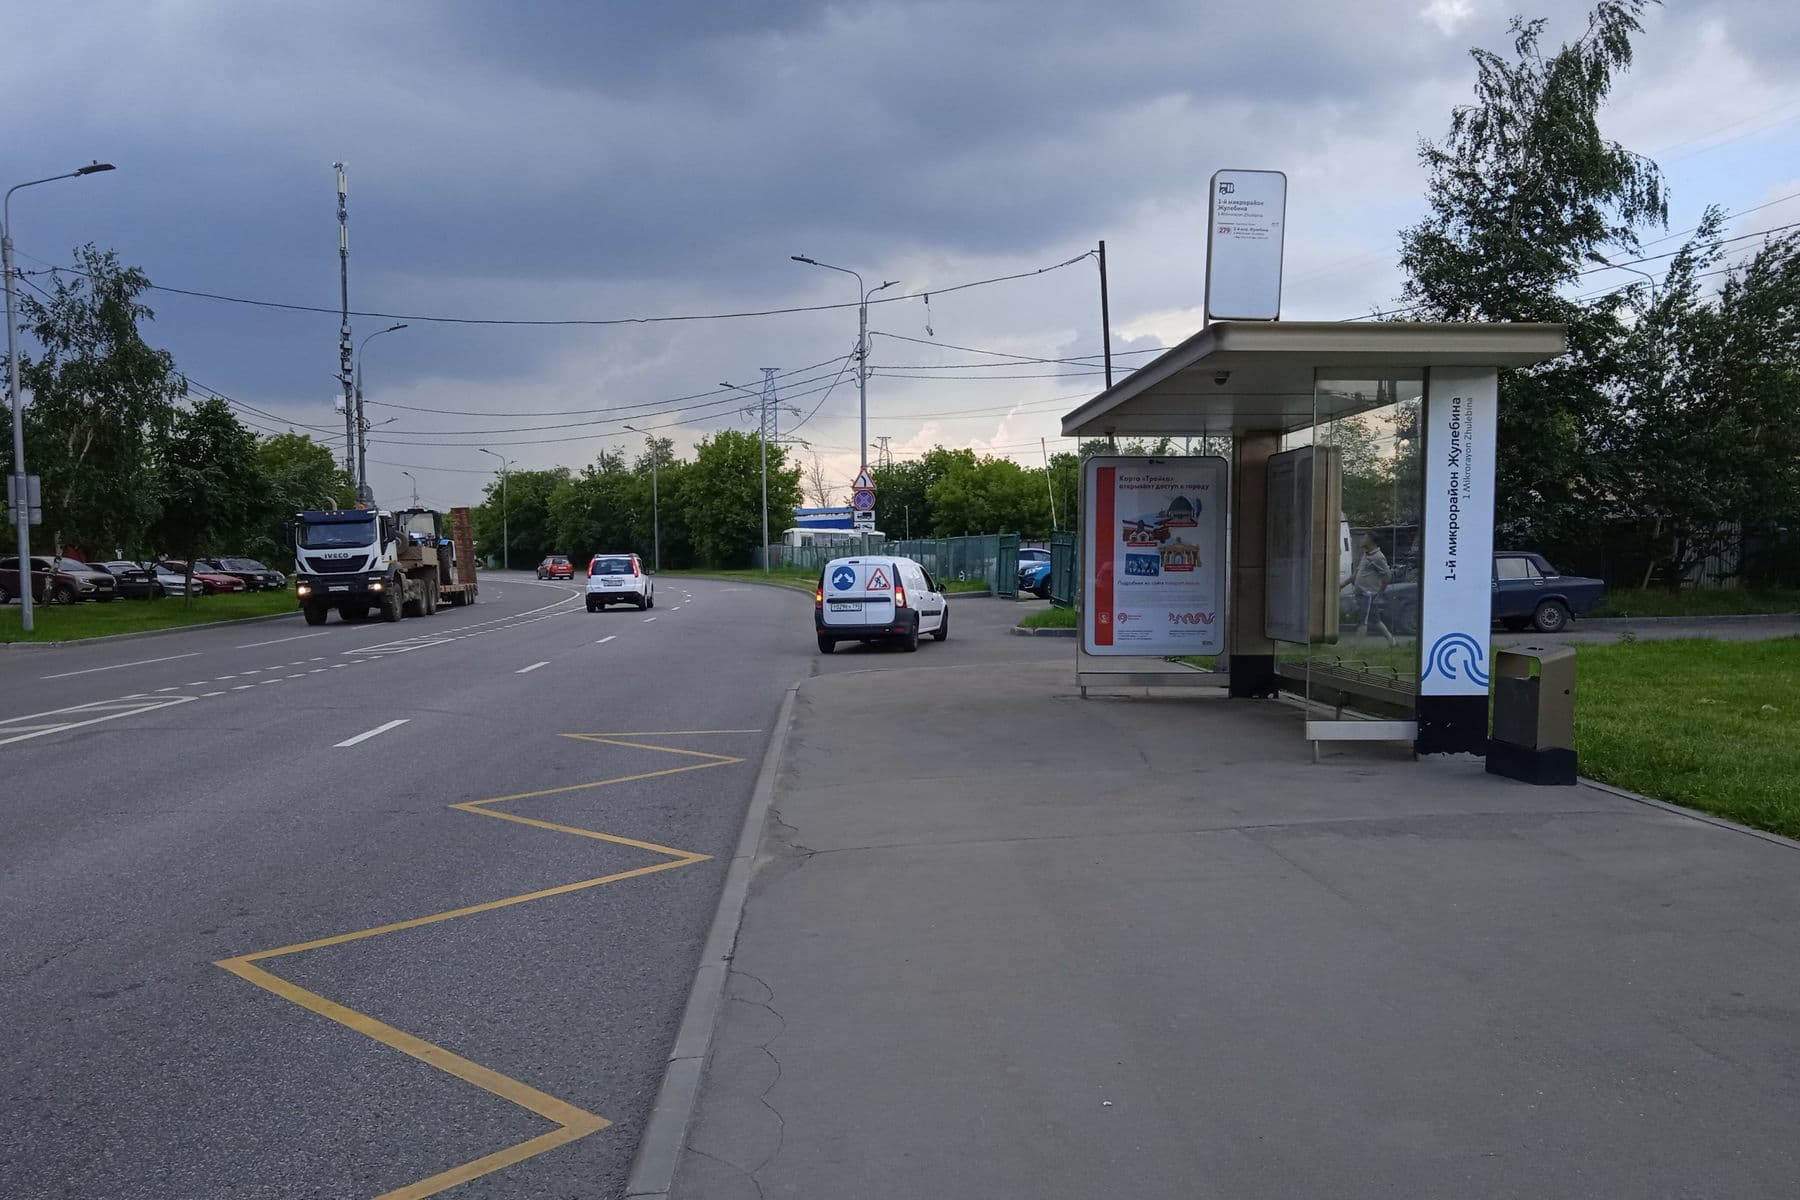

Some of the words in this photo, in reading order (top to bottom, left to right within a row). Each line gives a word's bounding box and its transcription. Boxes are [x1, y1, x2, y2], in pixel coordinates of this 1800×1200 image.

[1448, 397, 1462, 468] Жулебина
[1463, 397, 1473, 441] Zhulebina
[1463, 444, 1473, 493] Mikrorayon
[1447, 471, 1461, 557] микрорайон
[1444, 559, 1456, 581] 1-й
